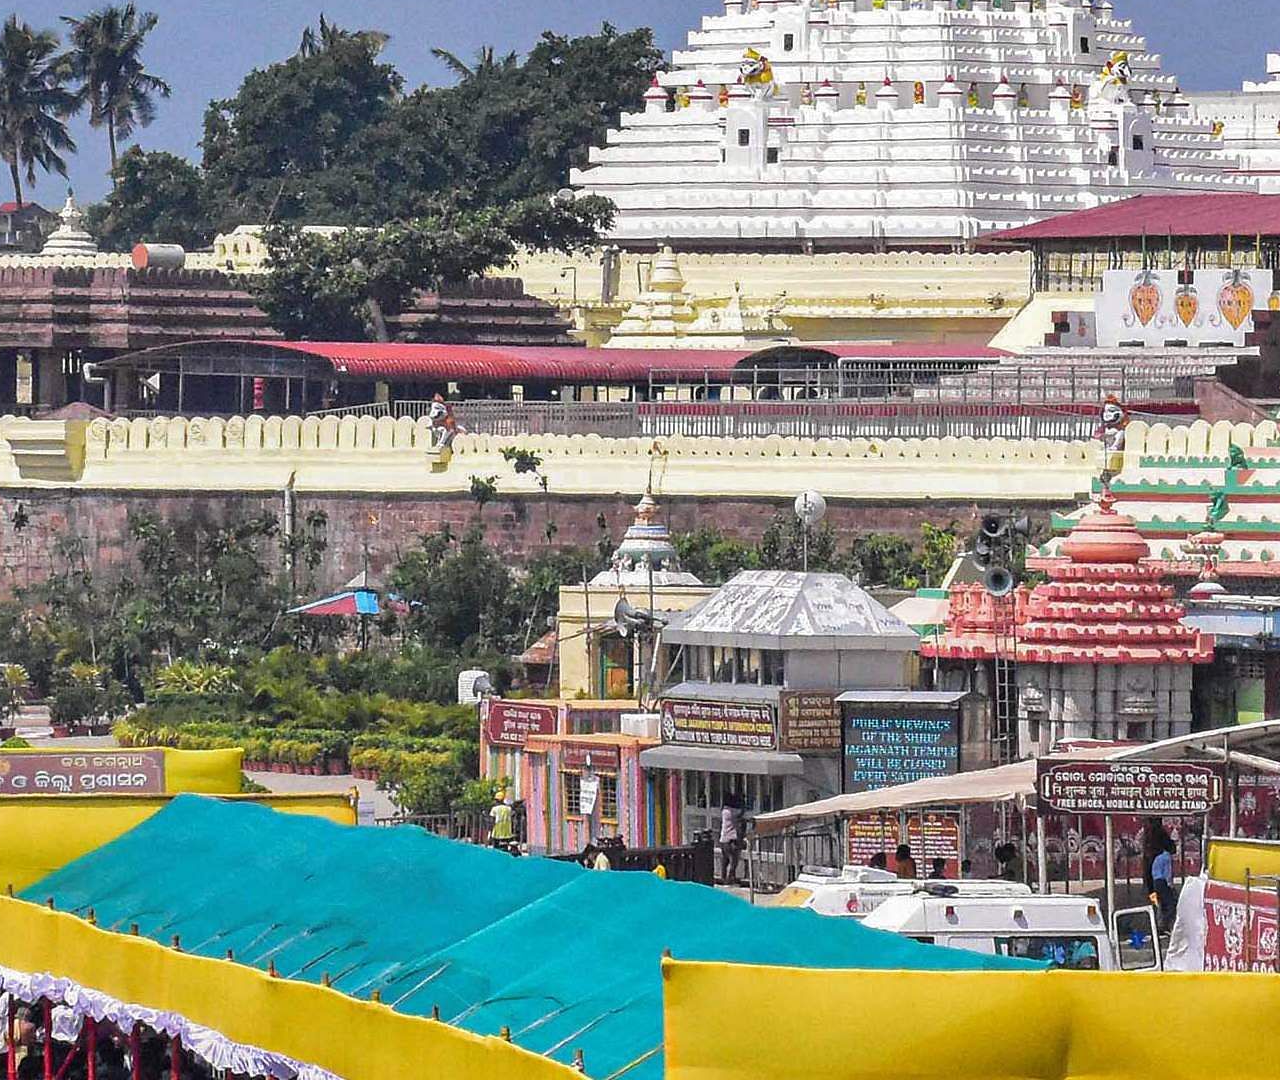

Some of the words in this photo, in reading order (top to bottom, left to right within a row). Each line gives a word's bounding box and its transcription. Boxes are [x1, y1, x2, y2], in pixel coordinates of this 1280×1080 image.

[852, 718, 892, 728] PUBLIC
[894, 719, 951, 730] VIEWINGS
[862, 732, 877, 741] OF
[880, 732, 901, 742] THE
[904, 733, 940, 743] SHREE
[911, 746, 958, 757] TEMPLE
[61, 756, 88, 768] ଜୟ
[93, 755, 144, 769] ଜଗନ୍ନାଥ
[856, 758, 884, 768] WILL
[887, 758, 901, 769] BE
[903, 759, 946, 770] CLOSED
[11, 775, 29, 788] ଓ
[79, 773, 148, 790] ପ୍ରଶାସନ
[854, 771, 886, 781] EVERY
[1137, 773, 1147, 782] ଓ
[1056, 799, 1076, 808] FREE
[1077, 799, 1104, 809] SHOES,
[1106, 799, 1134, 809] MOBILE
[1136, 800, 1142, 809] &
[1143, 800, 1180, 809] LUGGAGE
[1181, 801, 1207, 810] STAND
